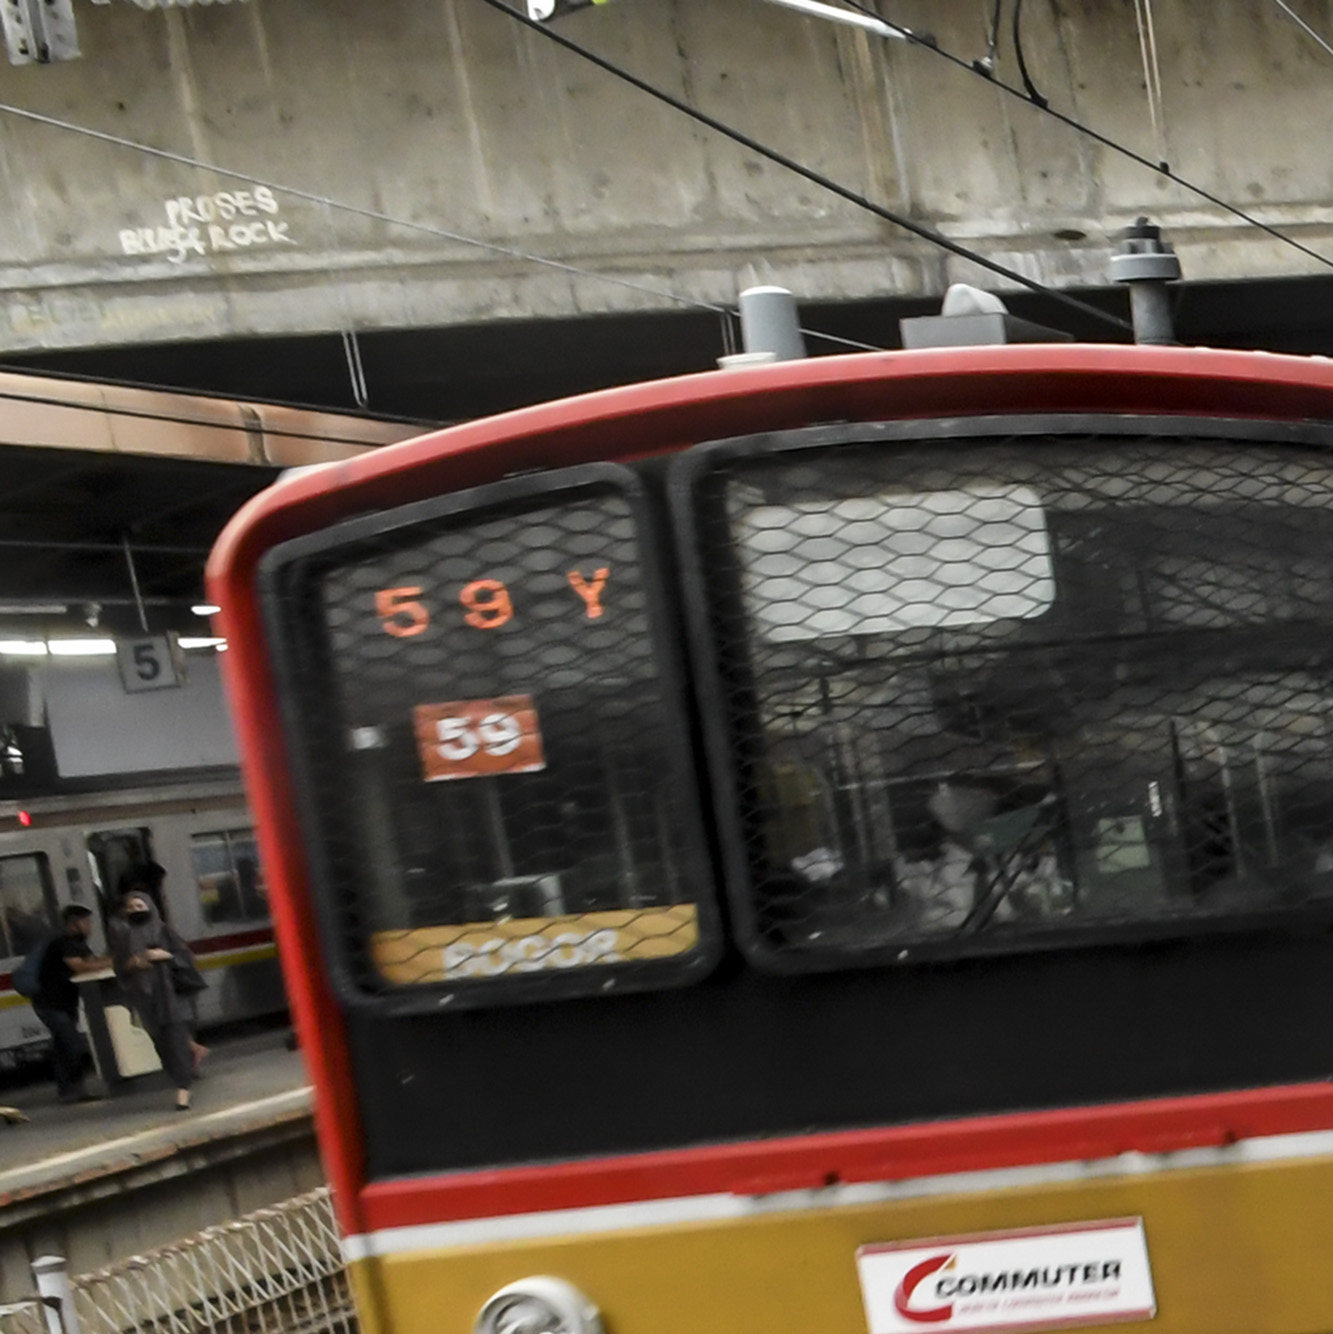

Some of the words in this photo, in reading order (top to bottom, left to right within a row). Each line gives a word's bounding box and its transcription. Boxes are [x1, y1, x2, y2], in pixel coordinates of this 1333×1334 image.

[208, 220, 298, 250] ROCK
[133, 644, 160, 681] 5
[436, 713, 524, 760] 59
[443, 929, 621, 979] BOGOR
[935, 1260, 1122, 1299] COMMUTER
